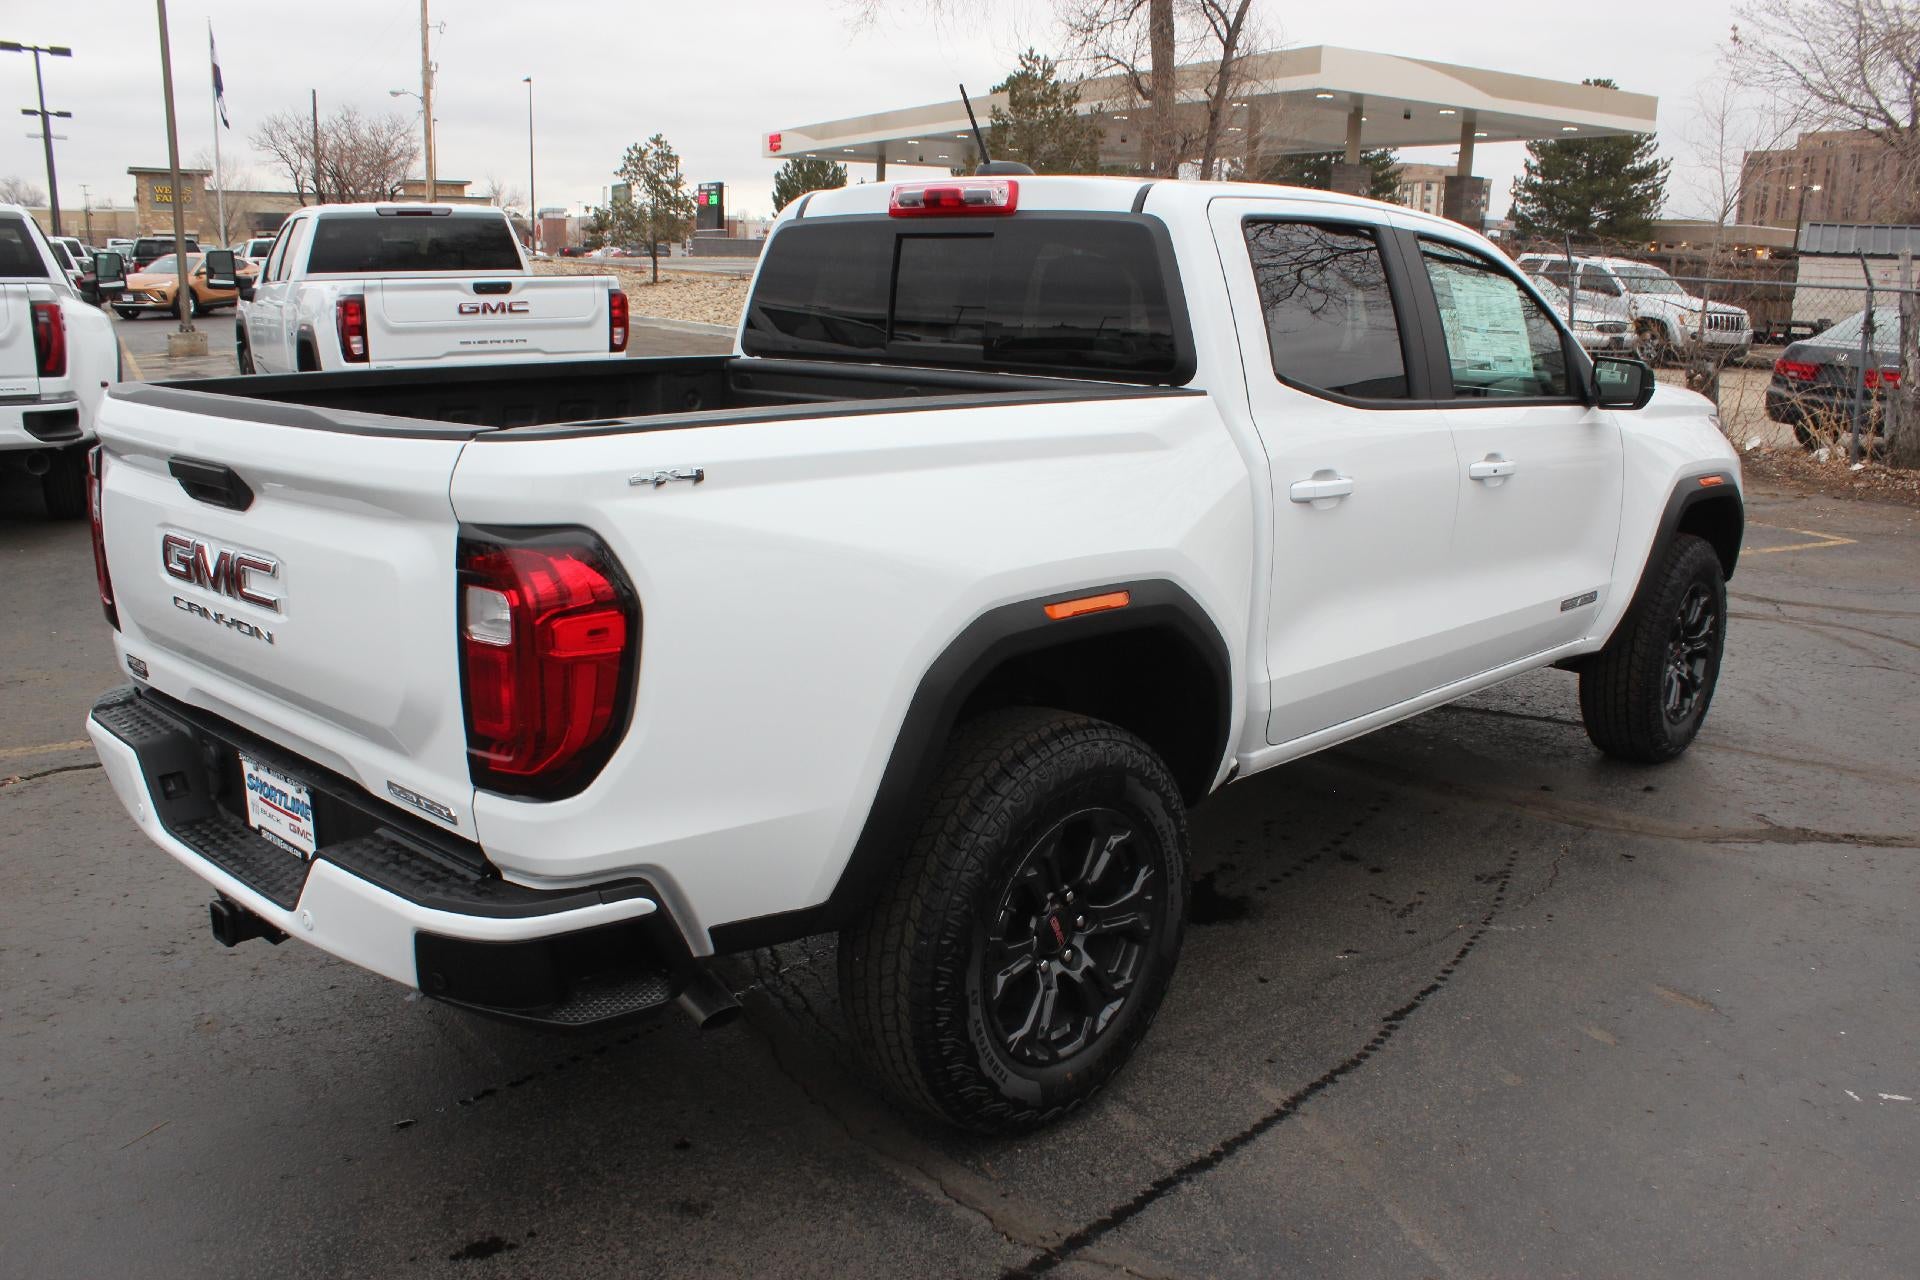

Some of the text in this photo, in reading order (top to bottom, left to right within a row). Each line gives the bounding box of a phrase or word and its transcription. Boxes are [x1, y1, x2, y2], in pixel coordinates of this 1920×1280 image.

[458, 301, 530, 315] GMC
[162, 530, 281, 614] GMC
[172, 595, 275, 644] CANYON
[246, 773, 311, 822] SHORTLINE
[260, 807, 281, 825] BUICK
[288, 822, 313, 844] GMC
[974, 1018, 1009, 1084] TERRITORY
